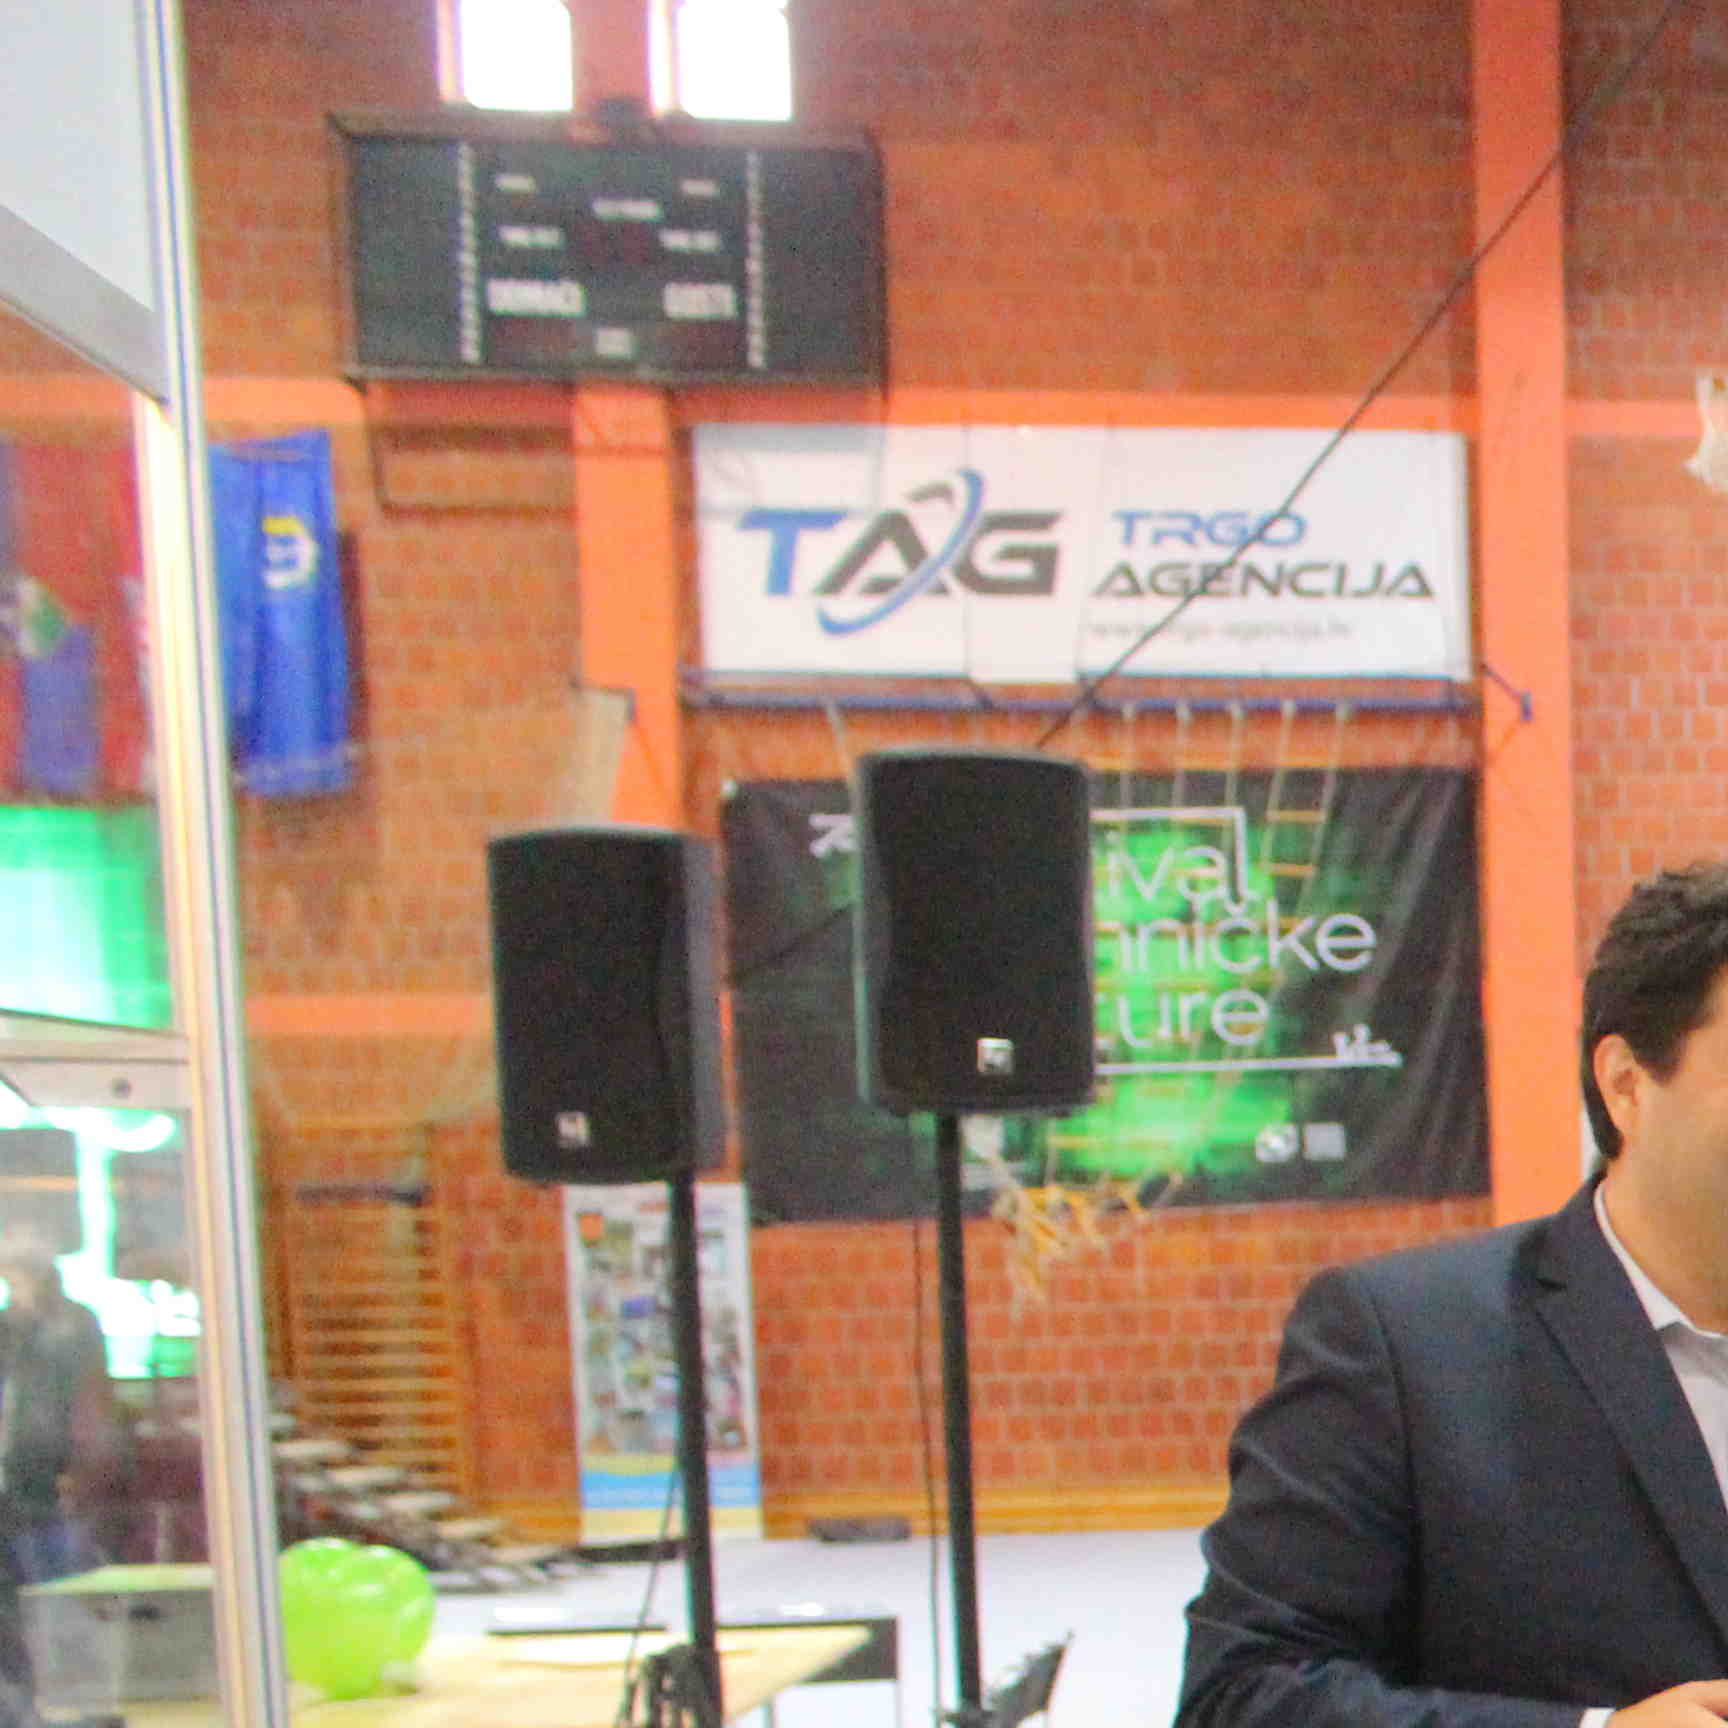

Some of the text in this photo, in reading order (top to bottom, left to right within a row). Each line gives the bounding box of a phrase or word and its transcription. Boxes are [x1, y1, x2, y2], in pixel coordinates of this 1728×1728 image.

[1111, 508, 1309, 548] TRGO
[735, 504, 1065, 598] TAG
[1090, 560, 1435, 598] AGENCIJA
